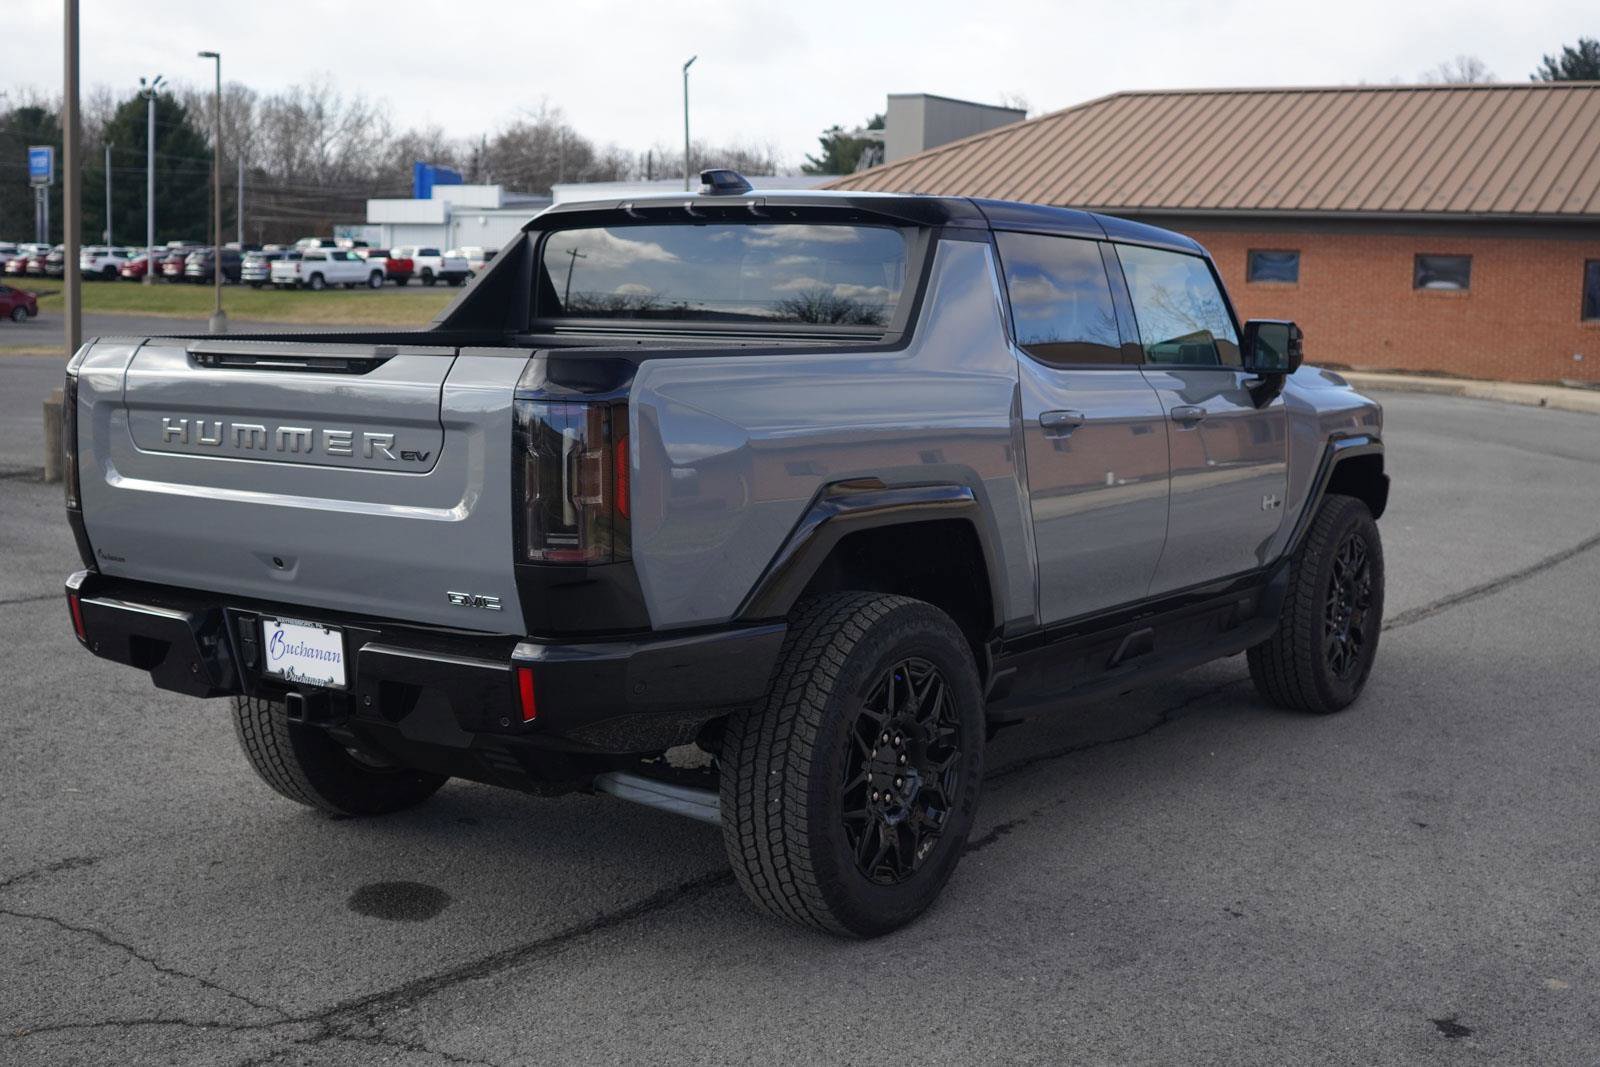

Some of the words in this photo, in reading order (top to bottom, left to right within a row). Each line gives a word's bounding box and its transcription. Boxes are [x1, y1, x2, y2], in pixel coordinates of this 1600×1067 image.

[162, 417, 396, 460] HUMMER
[400, 450, 430, 462] EV
[446, 591, 502, 610] GMC
[270, 630, 341, 663] Buchanan
